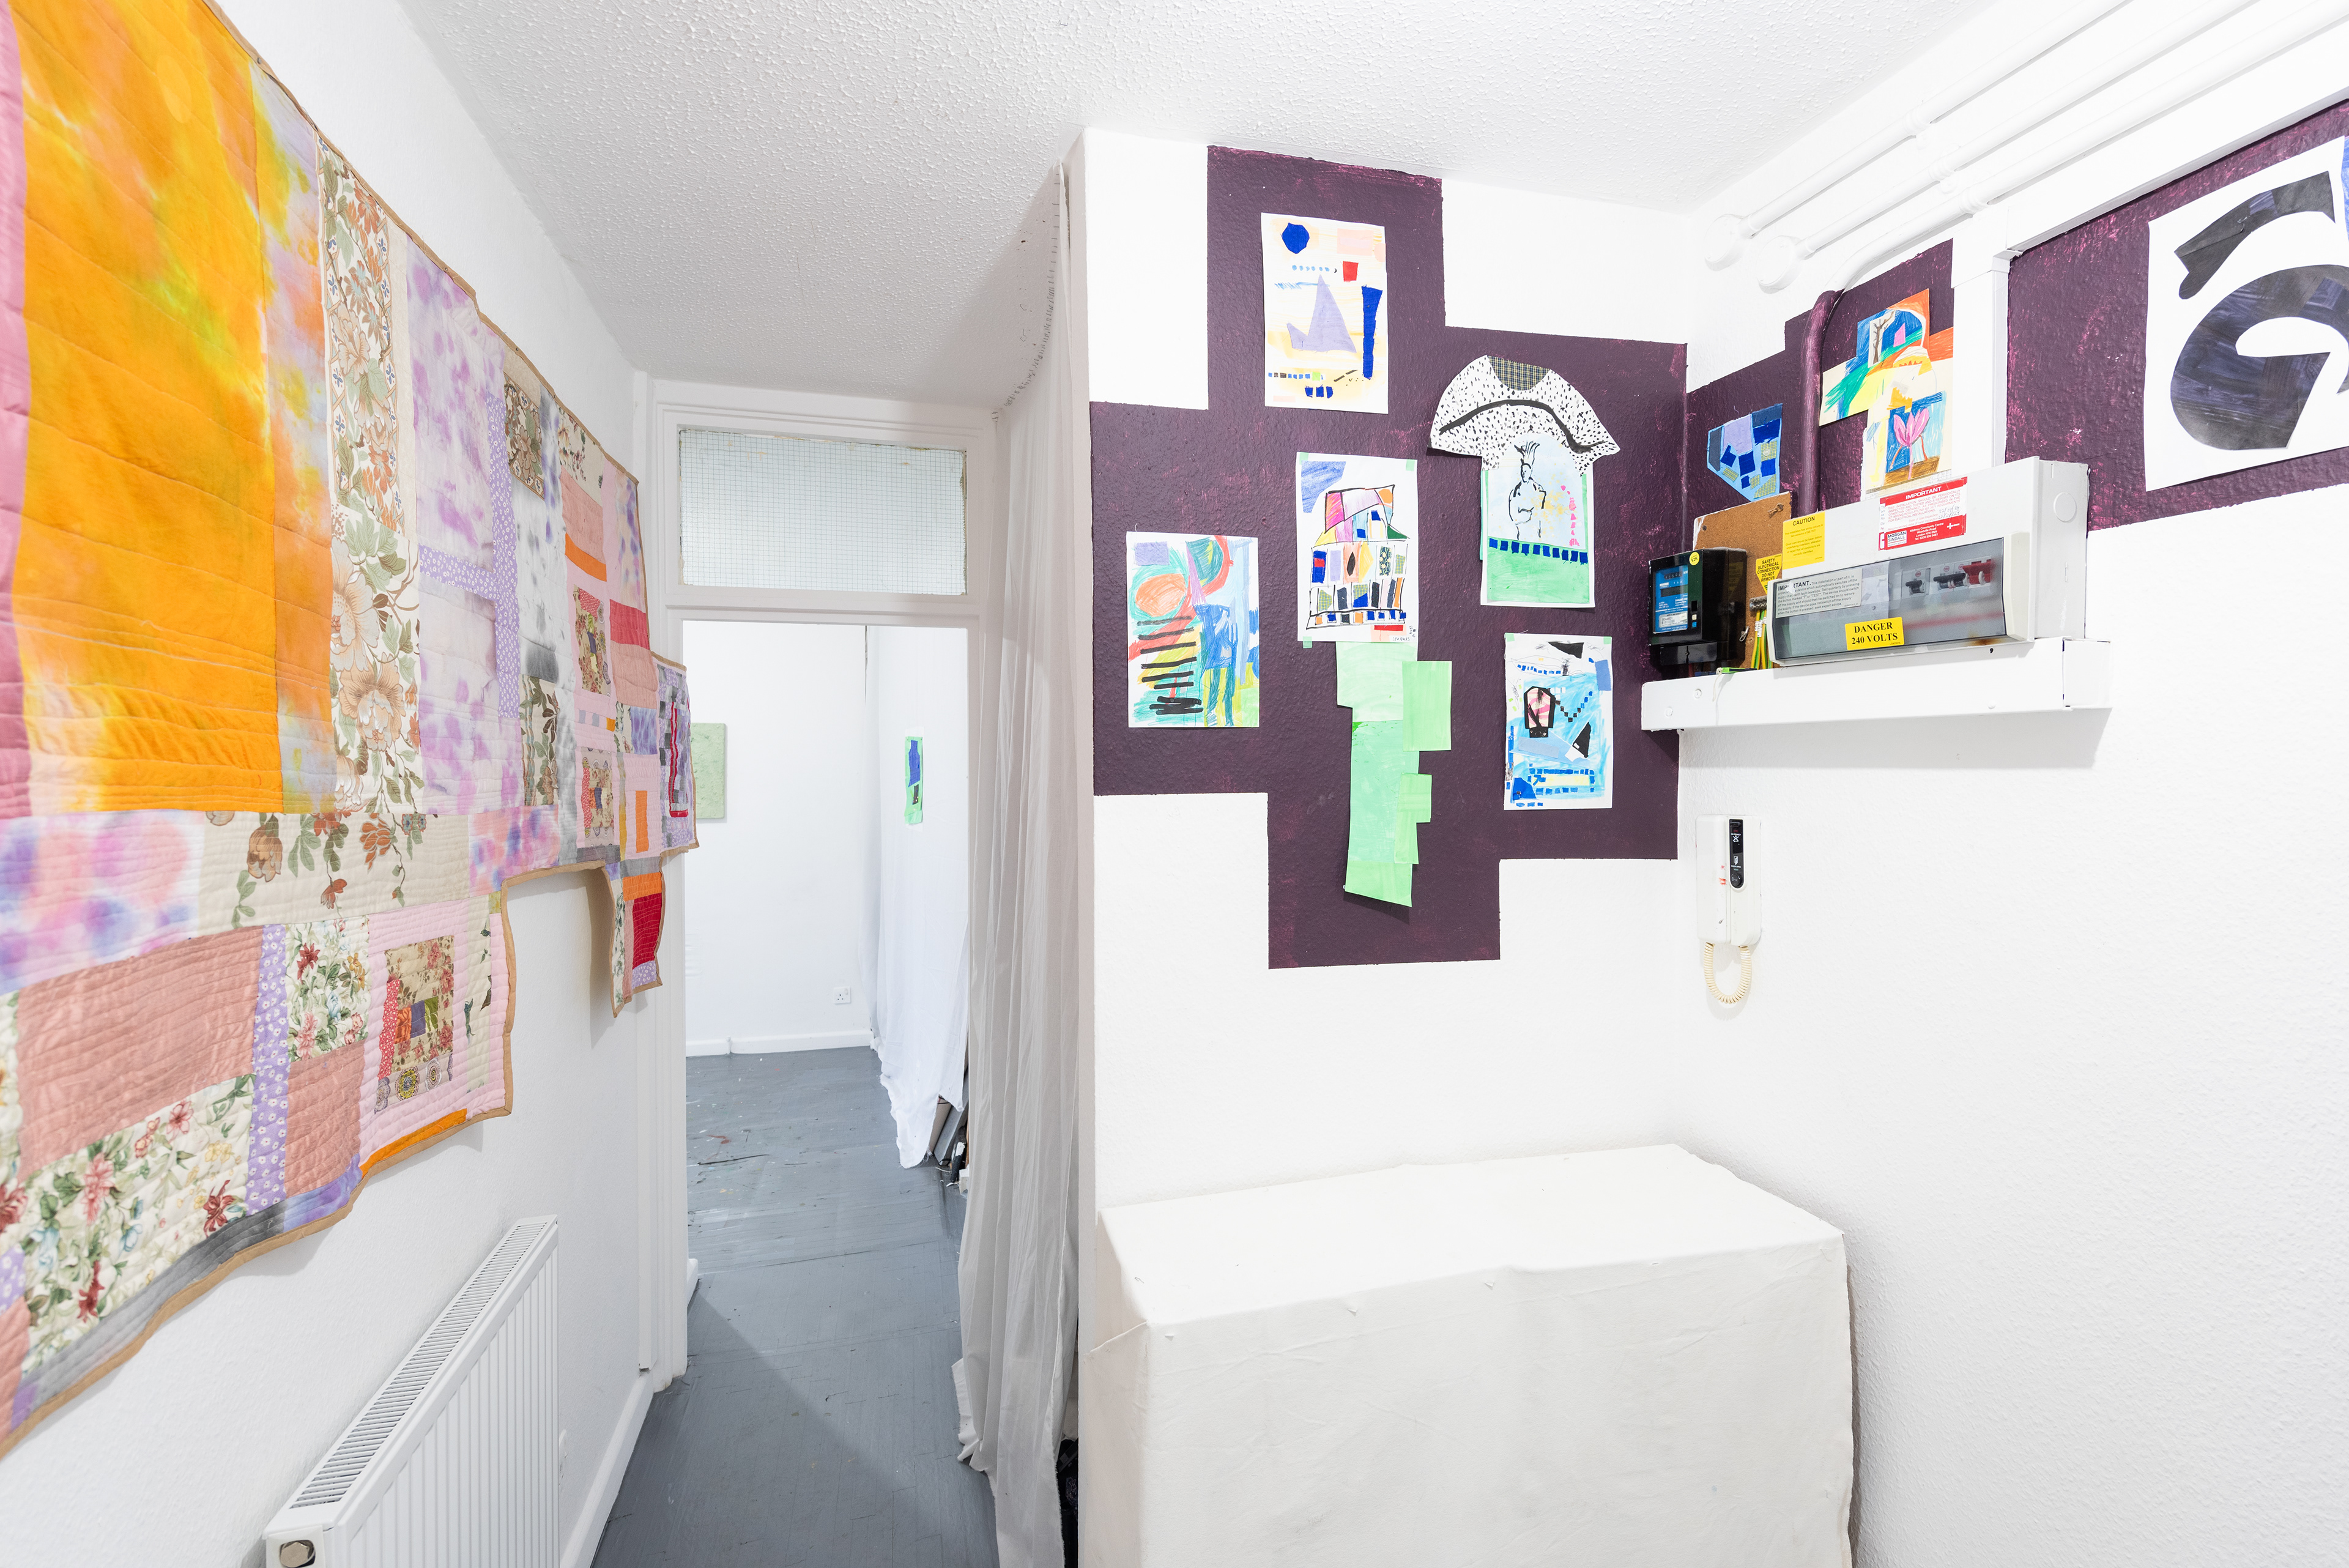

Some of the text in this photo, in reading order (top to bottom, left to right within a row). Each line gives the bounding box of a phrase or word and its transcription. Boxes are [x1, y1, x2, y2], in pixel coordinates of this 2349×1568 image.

[1906, 486, 1942, 499] IMPORTANT
[1792, 516, 1815, 526] CAUTION
[1778, 581, 1811, 590] IMPRTANT.
[1854, 622, 1893, 633] DANGER
[1867, 633, 1898, 642] VOLTS
